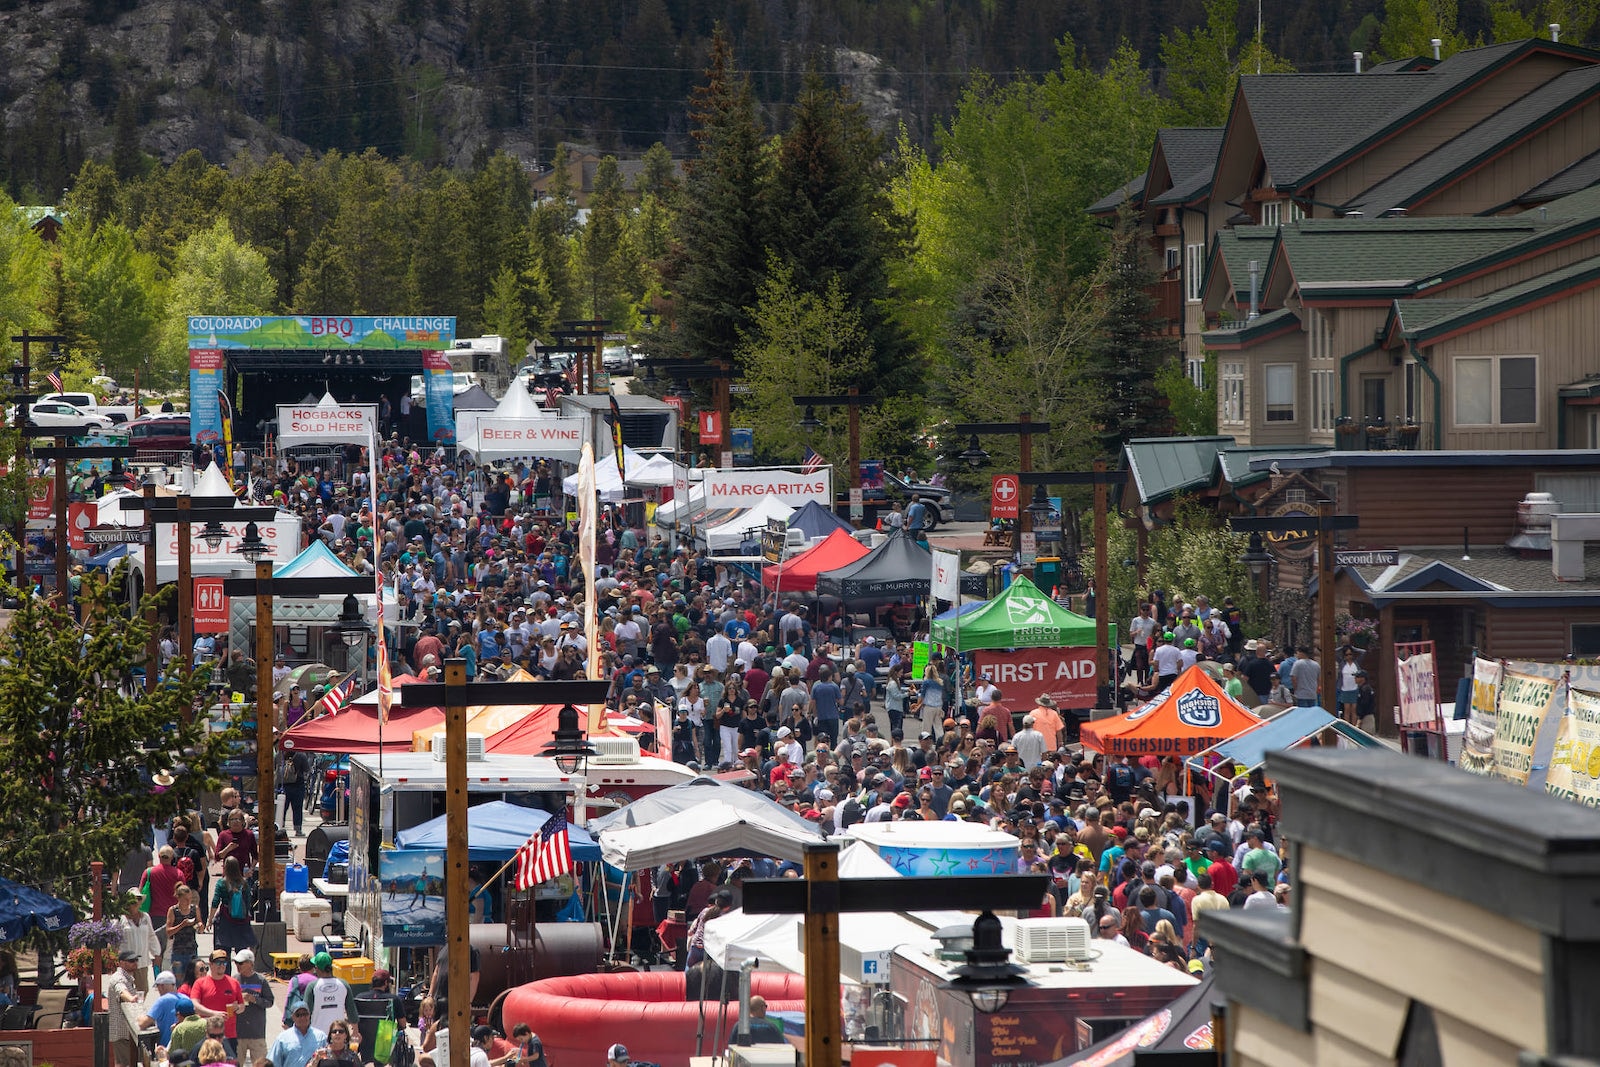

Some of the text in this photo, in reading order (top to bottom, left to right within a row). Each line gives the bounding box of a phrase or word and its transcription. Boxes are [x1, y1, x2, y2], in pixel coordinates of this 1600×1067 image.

[190, 318, 451, 338] COLORADO BBQ CHALLENGE
[292, 410, 362, 419] HOGBACKS
[291, 422, 364, 432] SOLD HERE
[483, 428, 522, 439] BEER
[526, 429, 538, 439] &
[540, 429, 580, 440] WINE
[712, 482, 825, 496] MARGARITAS
[89, 531, 122, 542] Second
[124, 532, 139, 542] Ave
[1336, 553, 1393, 564] Second Ave
[1014, 626, 1060, 635] FRISCO
[980, 659, 1096, 683] FIRST AID
[1114, 738, 1181, 752] HIGHSIDE
